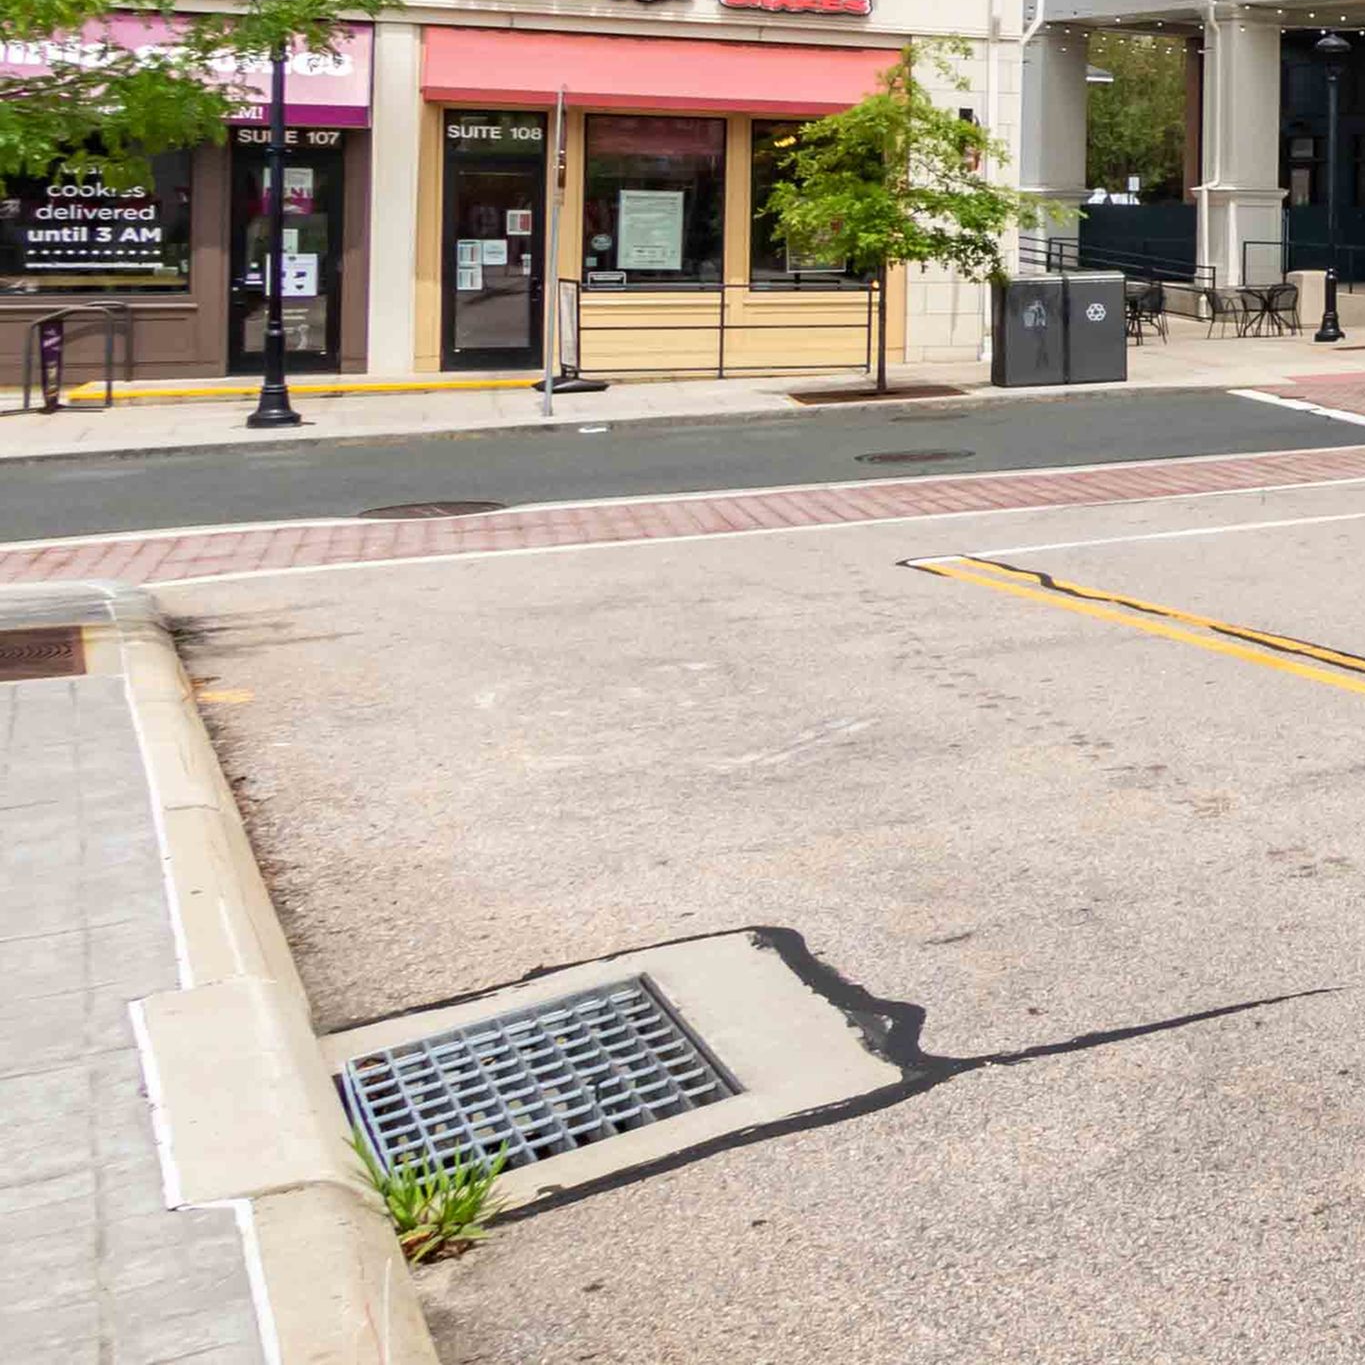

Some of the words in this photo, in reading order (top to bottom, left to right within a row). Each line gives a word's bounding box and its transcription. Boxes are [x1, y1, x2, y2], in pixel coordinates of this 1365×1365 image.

[238, 129, 299, 144] SUIE
[305, 131, 340, 145] 107
[447, 125, 502, 139] SUITE
[510, 127, 542, 140] 108
[35, 204, 156, 221] delivered
[27, 226, 88, 243] until
[96, 227, 112, 242] 3
[119, 227, 162, 242] AM
